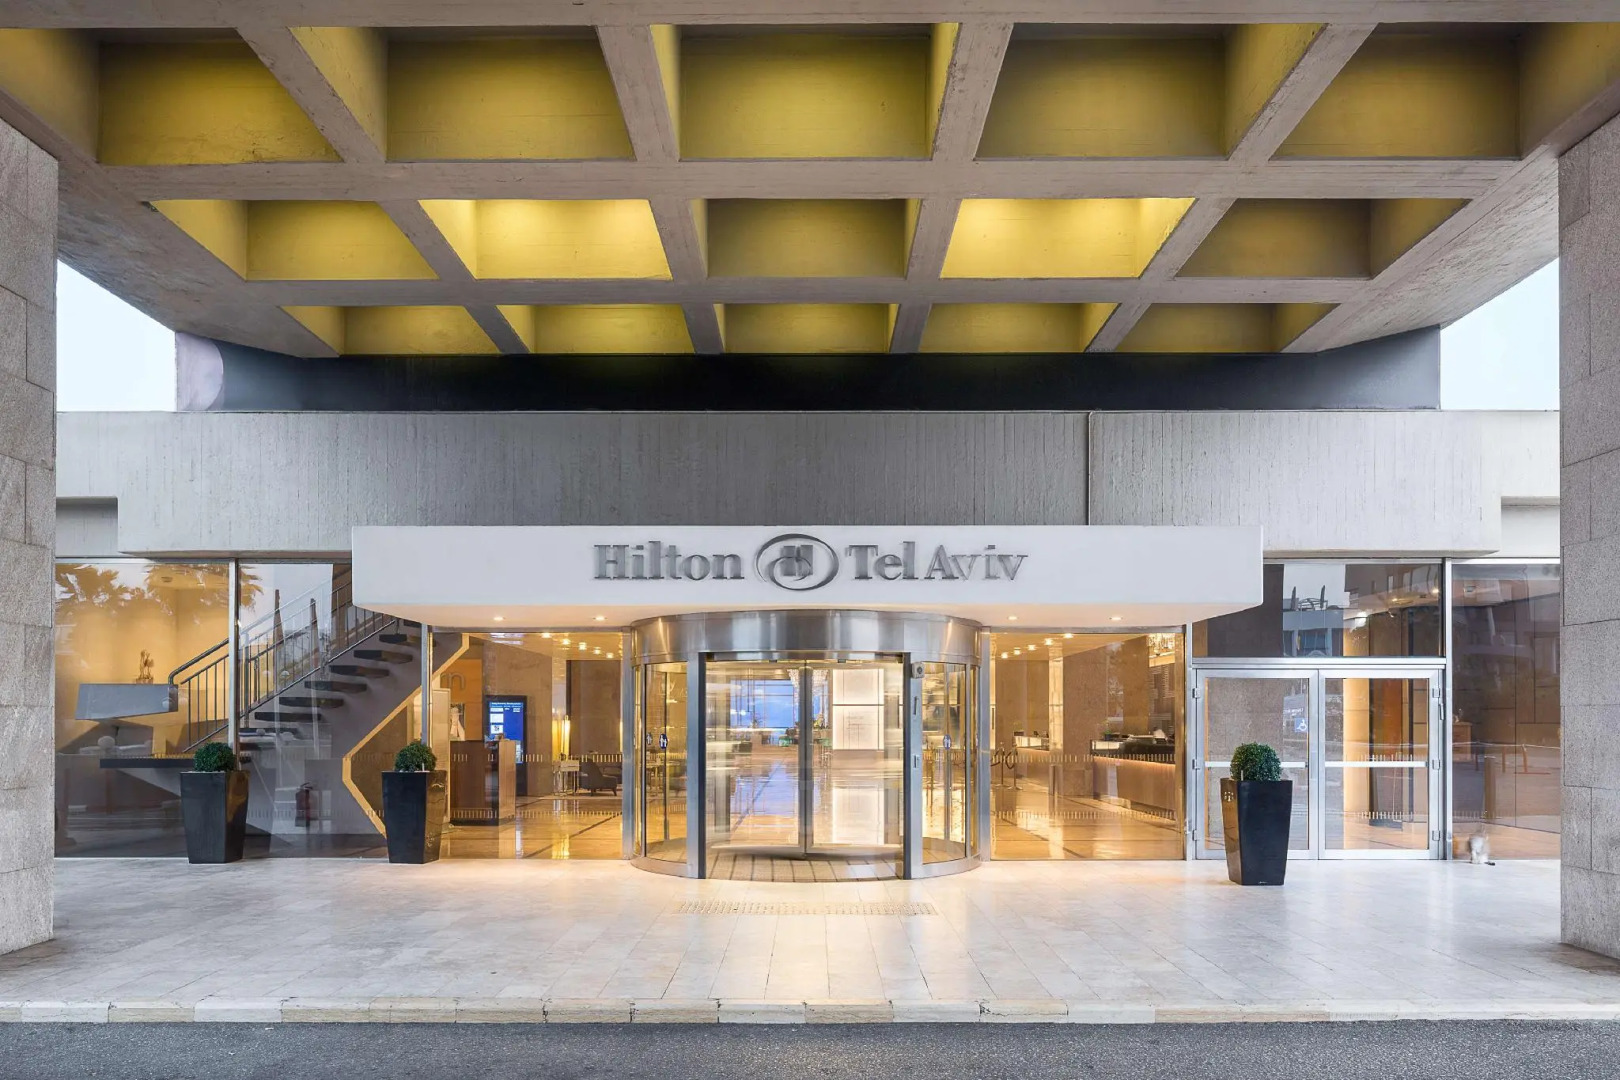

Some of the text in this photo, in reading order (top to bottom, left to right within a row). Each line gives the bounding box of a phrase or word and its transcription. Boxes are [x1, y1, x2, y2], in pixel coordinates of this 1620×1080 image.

[593, 541, 745, 581] Hilton
[847, 541, 919, 581] Tel
[923, 544, 1029, 581] Aviv
